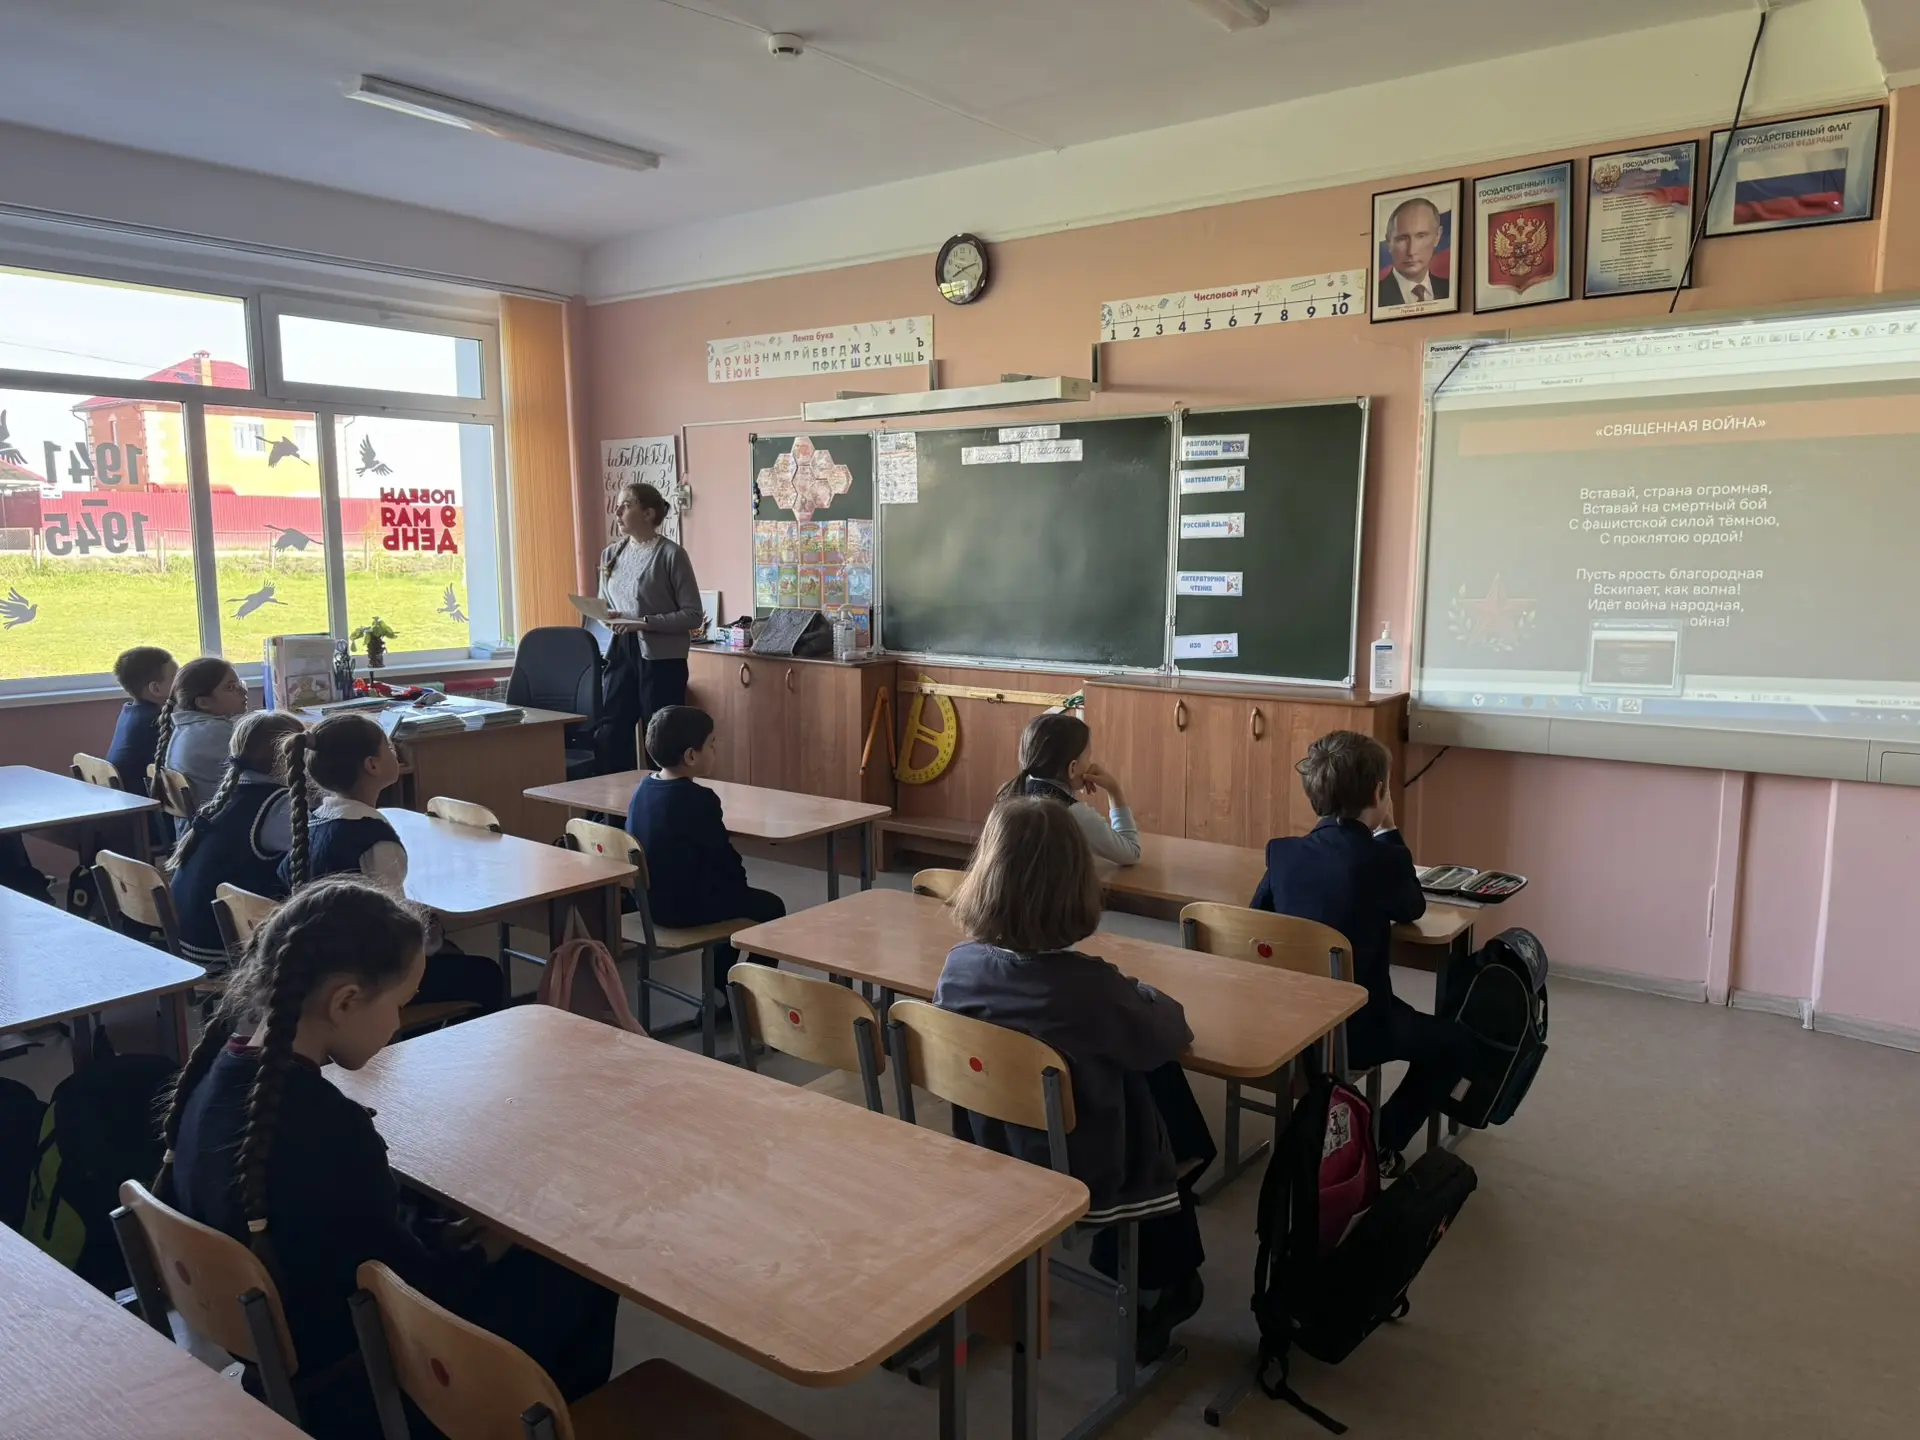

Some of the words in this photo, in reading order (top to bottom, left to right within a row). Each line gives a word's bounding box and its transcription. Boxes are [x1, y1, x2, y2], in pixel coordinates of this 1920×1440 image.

[1736, 125, 1825, 147] ГОСУДАРСТВЕННЫЙ
[1827, 122, 1852, 133] ФЛАГ
[1742, 141, 1795, 153] РОССИЙСКОЙ
[1796, 134, 1844, 147] ФЕДЕРАЦИИ
[1478, 179, 1546, 198] ГОСУДАРСТВЕННЫЙ
[1193, 288, 1239, 302] Числовой
[1241, 286, 1260, 298] луч
[1110, 329, 1117, 340] 1
[1132, 327, 1141, 338] 2
[1156, 323, 1164, 336] 3
[1178, 320, 1187, 333] 4
[1203, 318, 1212, 331] 5
[1228, 315, 1238, 328] 6
[1254, 312, 1263, 325] 7
[1279, 309, 1290, 322] 8
[1306, 306, 1317, 318] 9
[1331, 301, 1350, 315] 10
[792, 333, 815, 343] Лента
[815, 331, 834, 342] букв
[1430, 345, 1462, 353] Panasonic
[1595, 419, 1698, 437] «СВЯЩЕННАЯ
[1702, 414, 1767, 431] ВОЙНА»
[1186, 439, 1222, 447] РАЗГОВОРЫ
[1190, 449, 1219, 457] ВАЖНОМ
[1185, 475, 1227, 484] МАТЕМАТИКА
[1580, 486, 1639, 500] Вставай,
[1643, 486, 1692, 499] страна
[1696, 482, 1772, 498] огромная,
[1583, 502, 1638, 515] Вставай
[1642, 504, 1658, 513] на
[1662, 498, 1736, 514] смертный
[1739, 498, 1767, 510] бой
[1183, 520, 1210, 528] РУССКИЙ
[1568, 518, 1579, 530] С
[1582, 516, 1667, 531] фашистской
[1670, 514, 1714, 527] силой
[1718, 513, 1780, 528] тёмною,
[1600, 533, 1610, 544] С
[1613, 533, 1689, 546] проклятою
[1693, 530, 1743, 545] ордой!
[1576, 568, 1616, 582] Пусть
[1618, 569, 1666, 582] ярость
[1669, 567, 1764, 581] благородная
[1594, 583, 1661, 596] Вскипает,
[1664, 585, 1689, 596] как
[1692, 583, 1741, 596] волна!
[1587, 598, 1622, 612] Идёт
[1624, 599, 1667, 611] война
[1670, 600, 1744, 613] народная,
